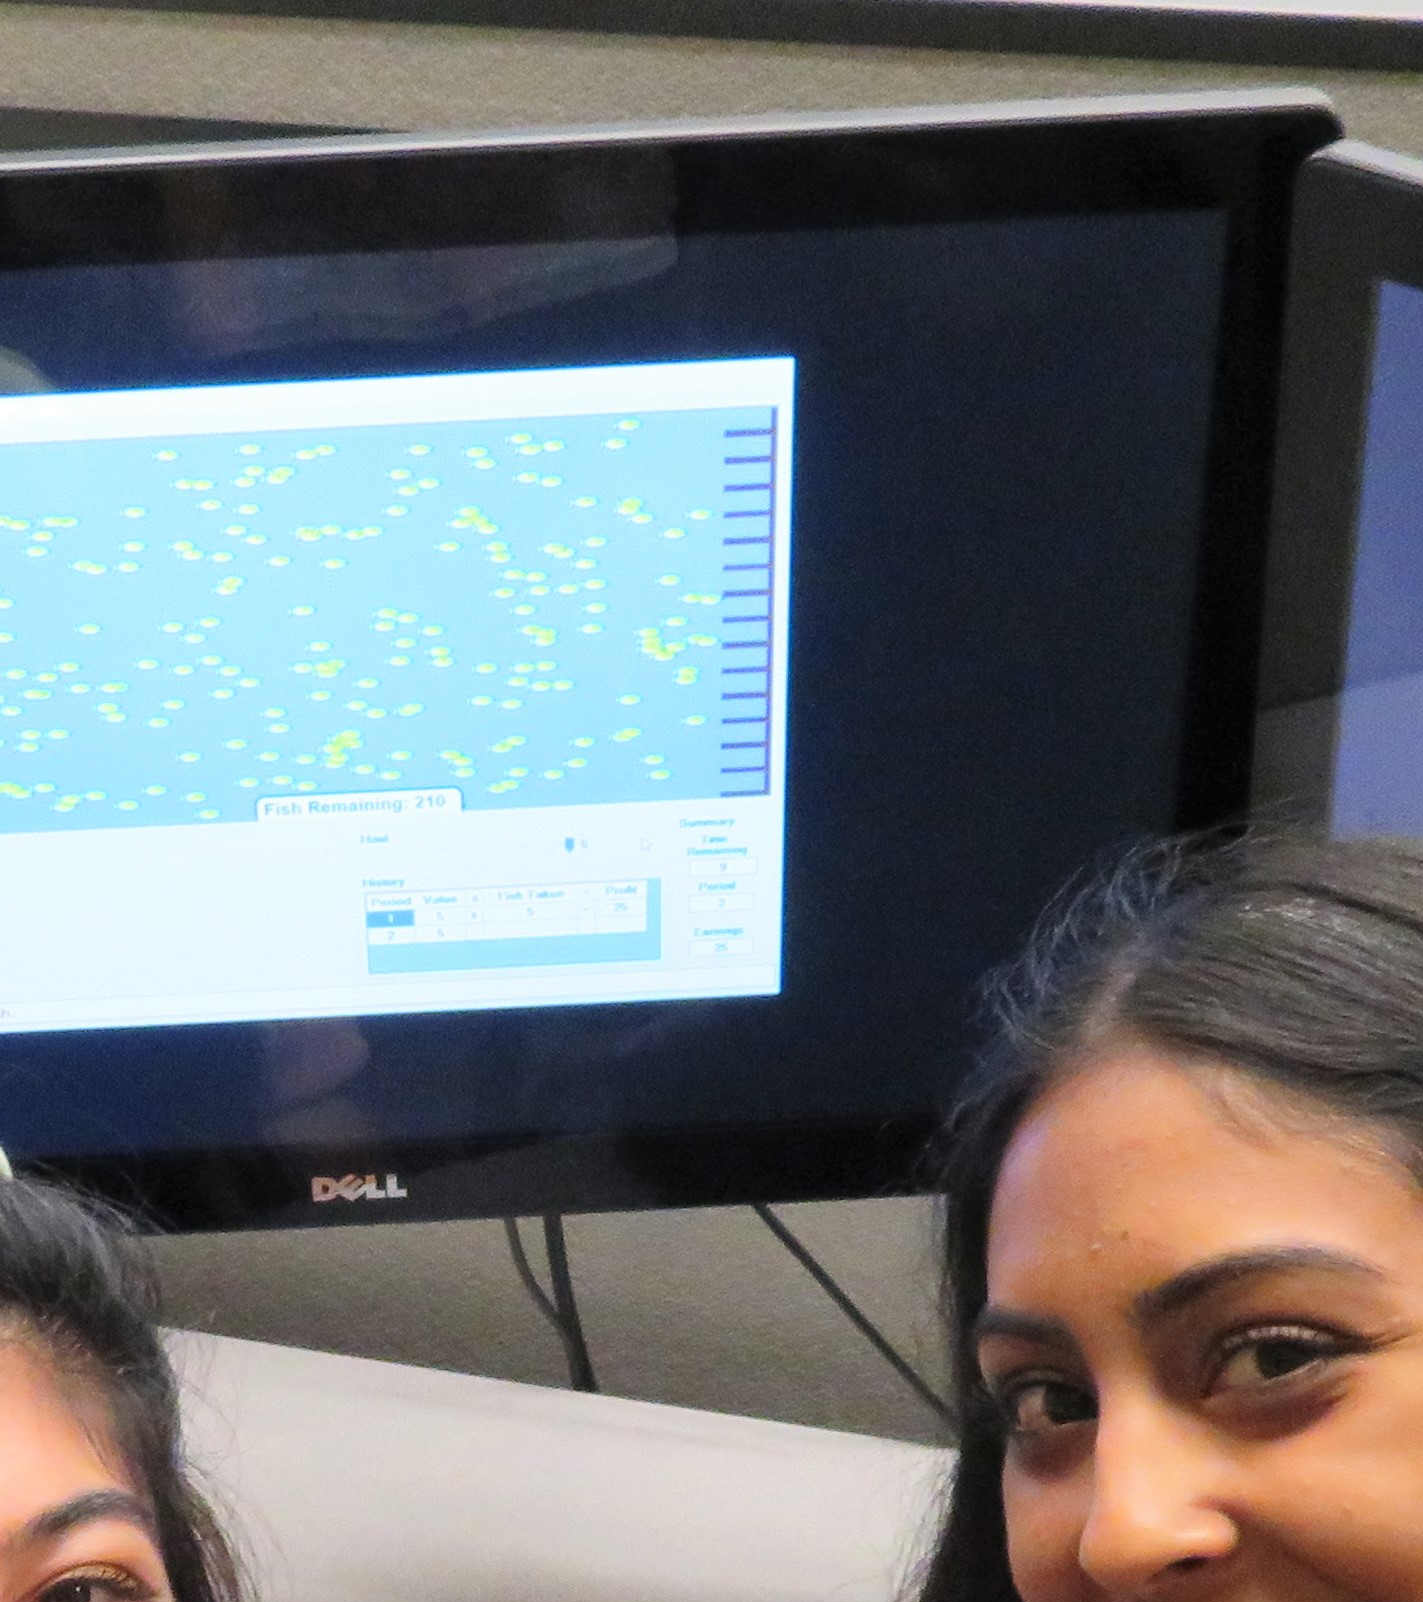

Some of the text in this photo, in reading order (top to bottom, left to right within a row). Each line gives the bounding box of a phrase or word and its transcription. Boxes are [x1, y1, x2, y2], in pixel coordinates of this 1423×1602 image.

[263, 793, 447, 816] Fish Remaining: 210
[361, 877, 406, 889] History
[697, 881, 737, 892] Period
[370, 895, 413, 907] Period
[423, 894, 458, 905] Value
[604, 885, 639, 896] Profit
[311, 1173, 408, 1203] DELL
